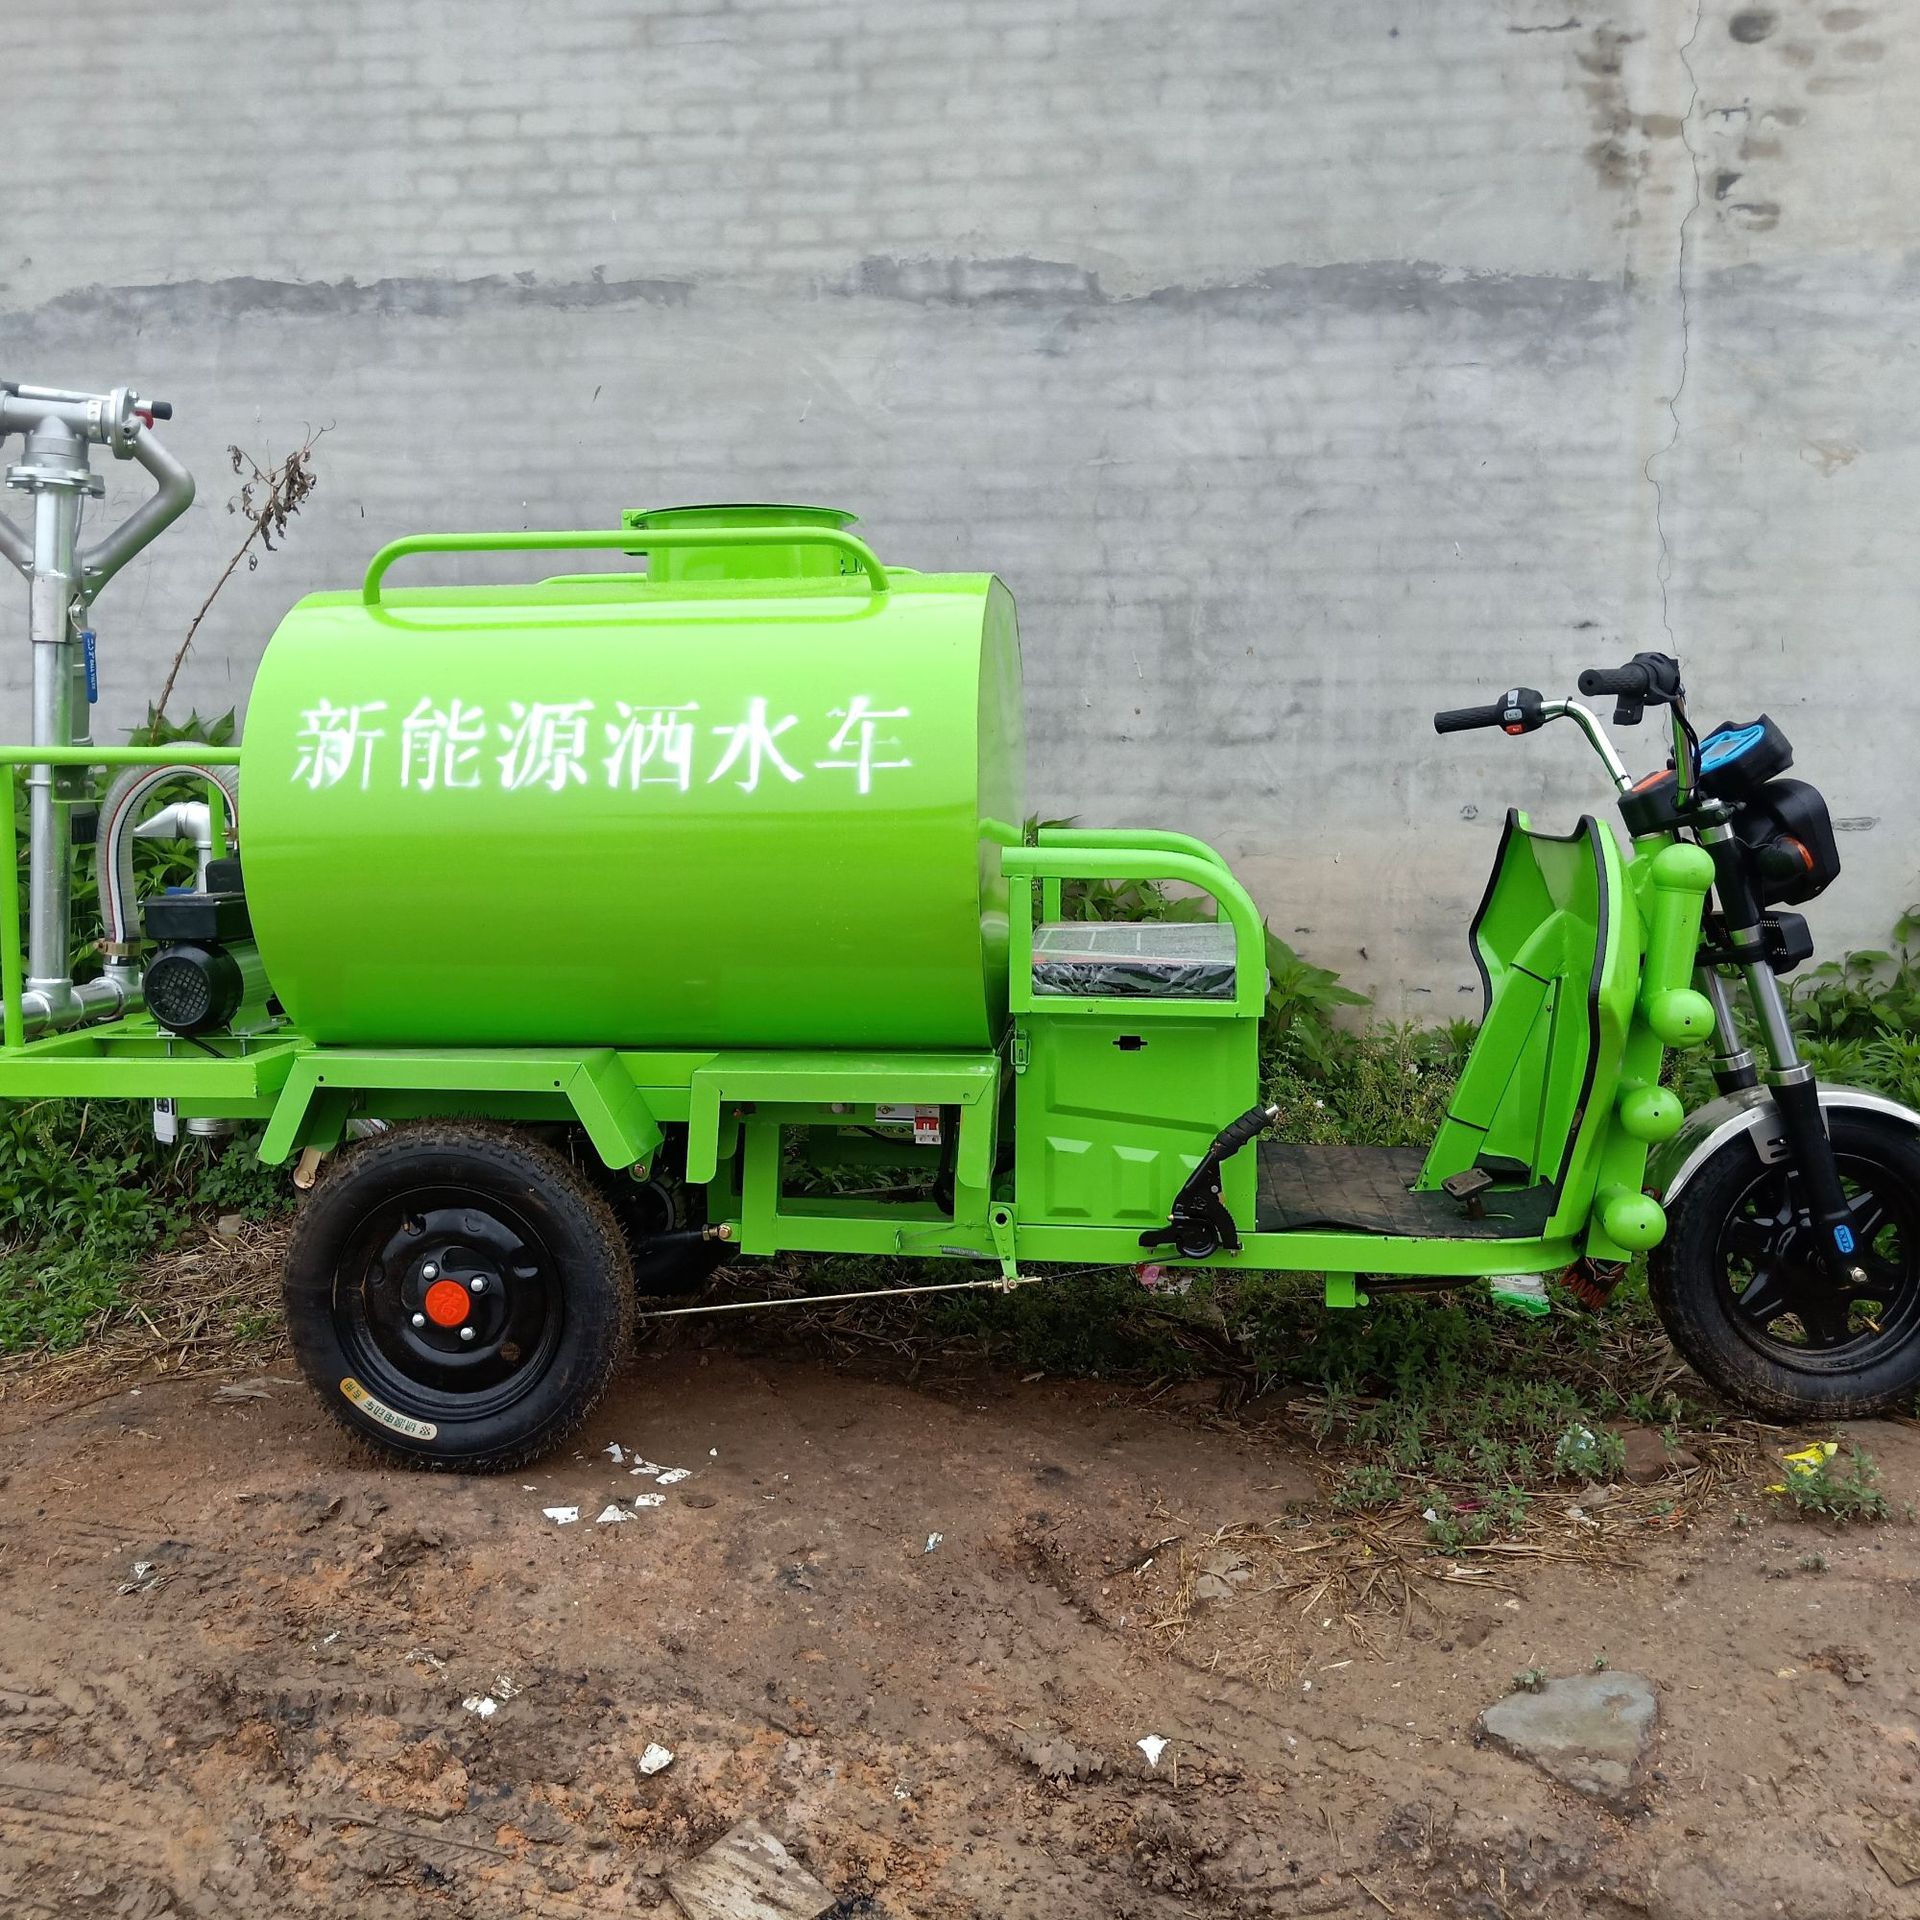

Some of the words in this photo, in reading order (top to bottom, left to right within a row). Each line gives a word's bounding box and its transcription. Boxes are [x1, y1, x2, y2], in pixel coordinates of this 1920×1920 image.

[290, 695, 913, 795] 新能源洒水车
